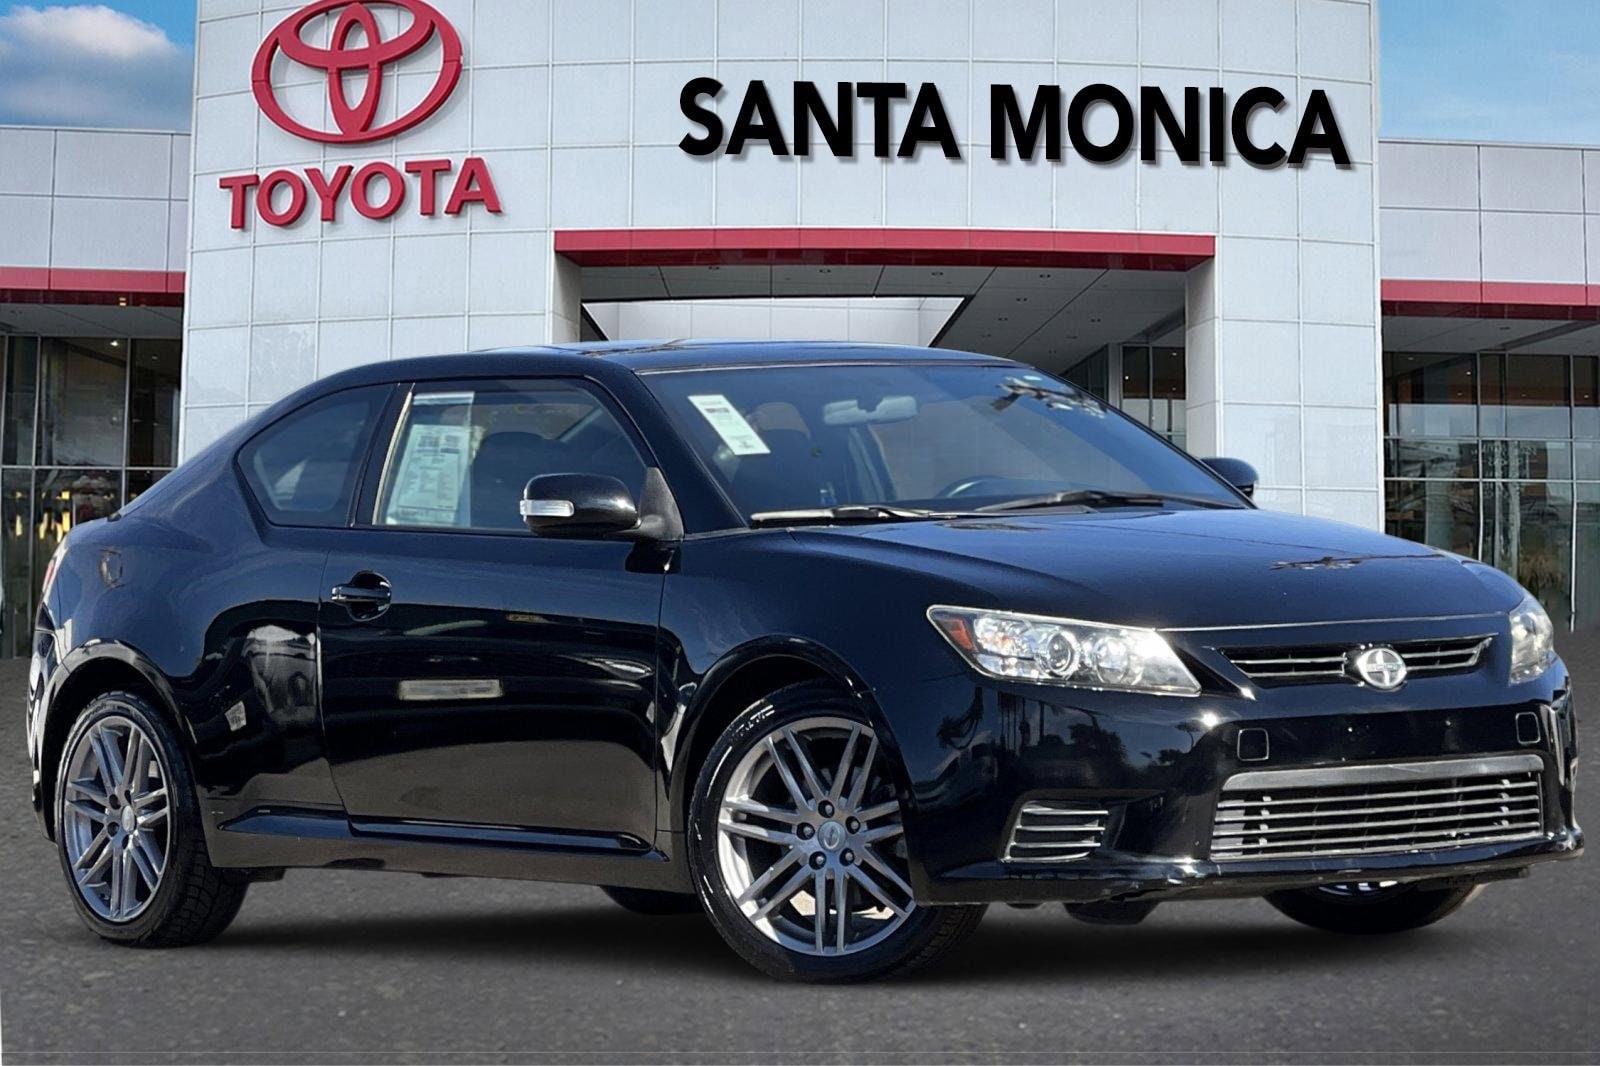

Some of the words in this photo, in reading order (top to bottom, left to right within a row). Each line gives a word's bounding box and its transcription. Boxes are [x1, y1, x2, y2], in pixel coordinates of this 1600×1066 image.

[678, 77, 962, 159] SANTA
[990, 84, 1351, 166] MONICA
[219, 156, 502, 230] TOYOTA
